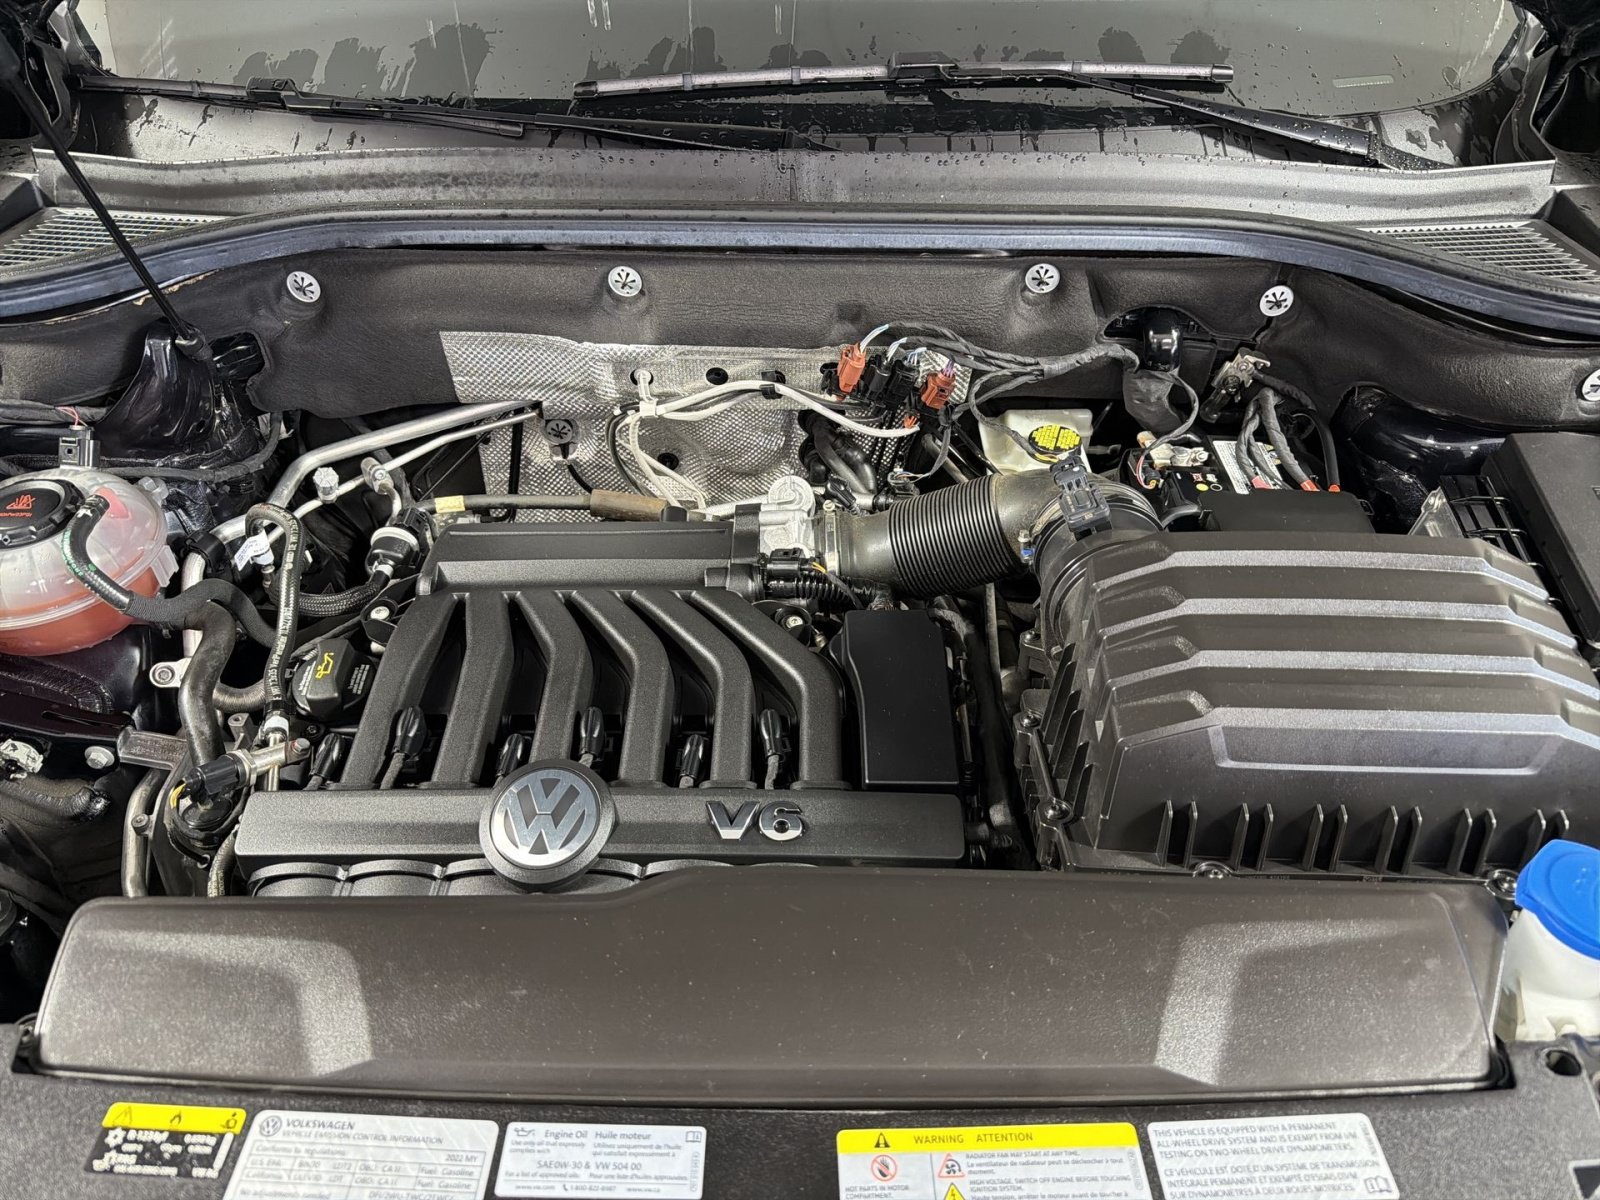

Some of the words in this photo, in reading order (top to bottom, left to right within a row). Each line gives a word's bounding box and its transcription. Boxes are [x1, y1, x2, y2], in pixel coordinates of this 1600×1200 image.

[706, 799, 805, 842] V6
[286, 1118, 355, 1130] VOLKSWAGEN
[1153, 1129, 1173, 1138] THIS
[1173, 1127, 1207, 1137] VEHICLE
[1207, 1127, 1216, 1136] IS
[1216, 1125, 1256, 1136] EQUIPPED
[1256, 1124, 1280, 1133] WITH
[1288, 1121, 1337, 1131] PERMANENT
[282, 1130, 313, 1139] VEHICLE
[314, 1131, 351, 1140] EMISSION
[353, 1132, 387, 1142] CONTROL
[389, 1134, 444, 1145] INFORMATION
[544, 1129, 574, 1140] Engine
[575, 1130, 588, 1139] Oil
[595, 1131, 618, 1140] Huile
[620, 1132, 652, 1140] moteur
[913, 1134, 965, 1145] WARNING
[976, 1132, 1034, 1143] ATTENTION
[1202, 1137, 1228, 1146] DRIVE
[1228, 1136, 1257, 1145] SYSTEM
[1258, 1135, 1279, 1143] AND
[1319, 1132, 1341, 1141] FROM
[1159, 1149, 1193, 1159] TESTING
[1194, 1149, 1208, 1157] ON
[1261, 1144, 1286, 1154] DRIVE
[445, 1153, 463, 1162] 2022
[465, 1154, 479, 1163] MY
[441, 1167, 474, 1177] Gasoline
[594, 1161, 611, 1170] VW
[612, 1161, 629, 1171] 504
[630, 1162, 643, 1171] 00
[438, 1180, 472, 1190] Gasoline
